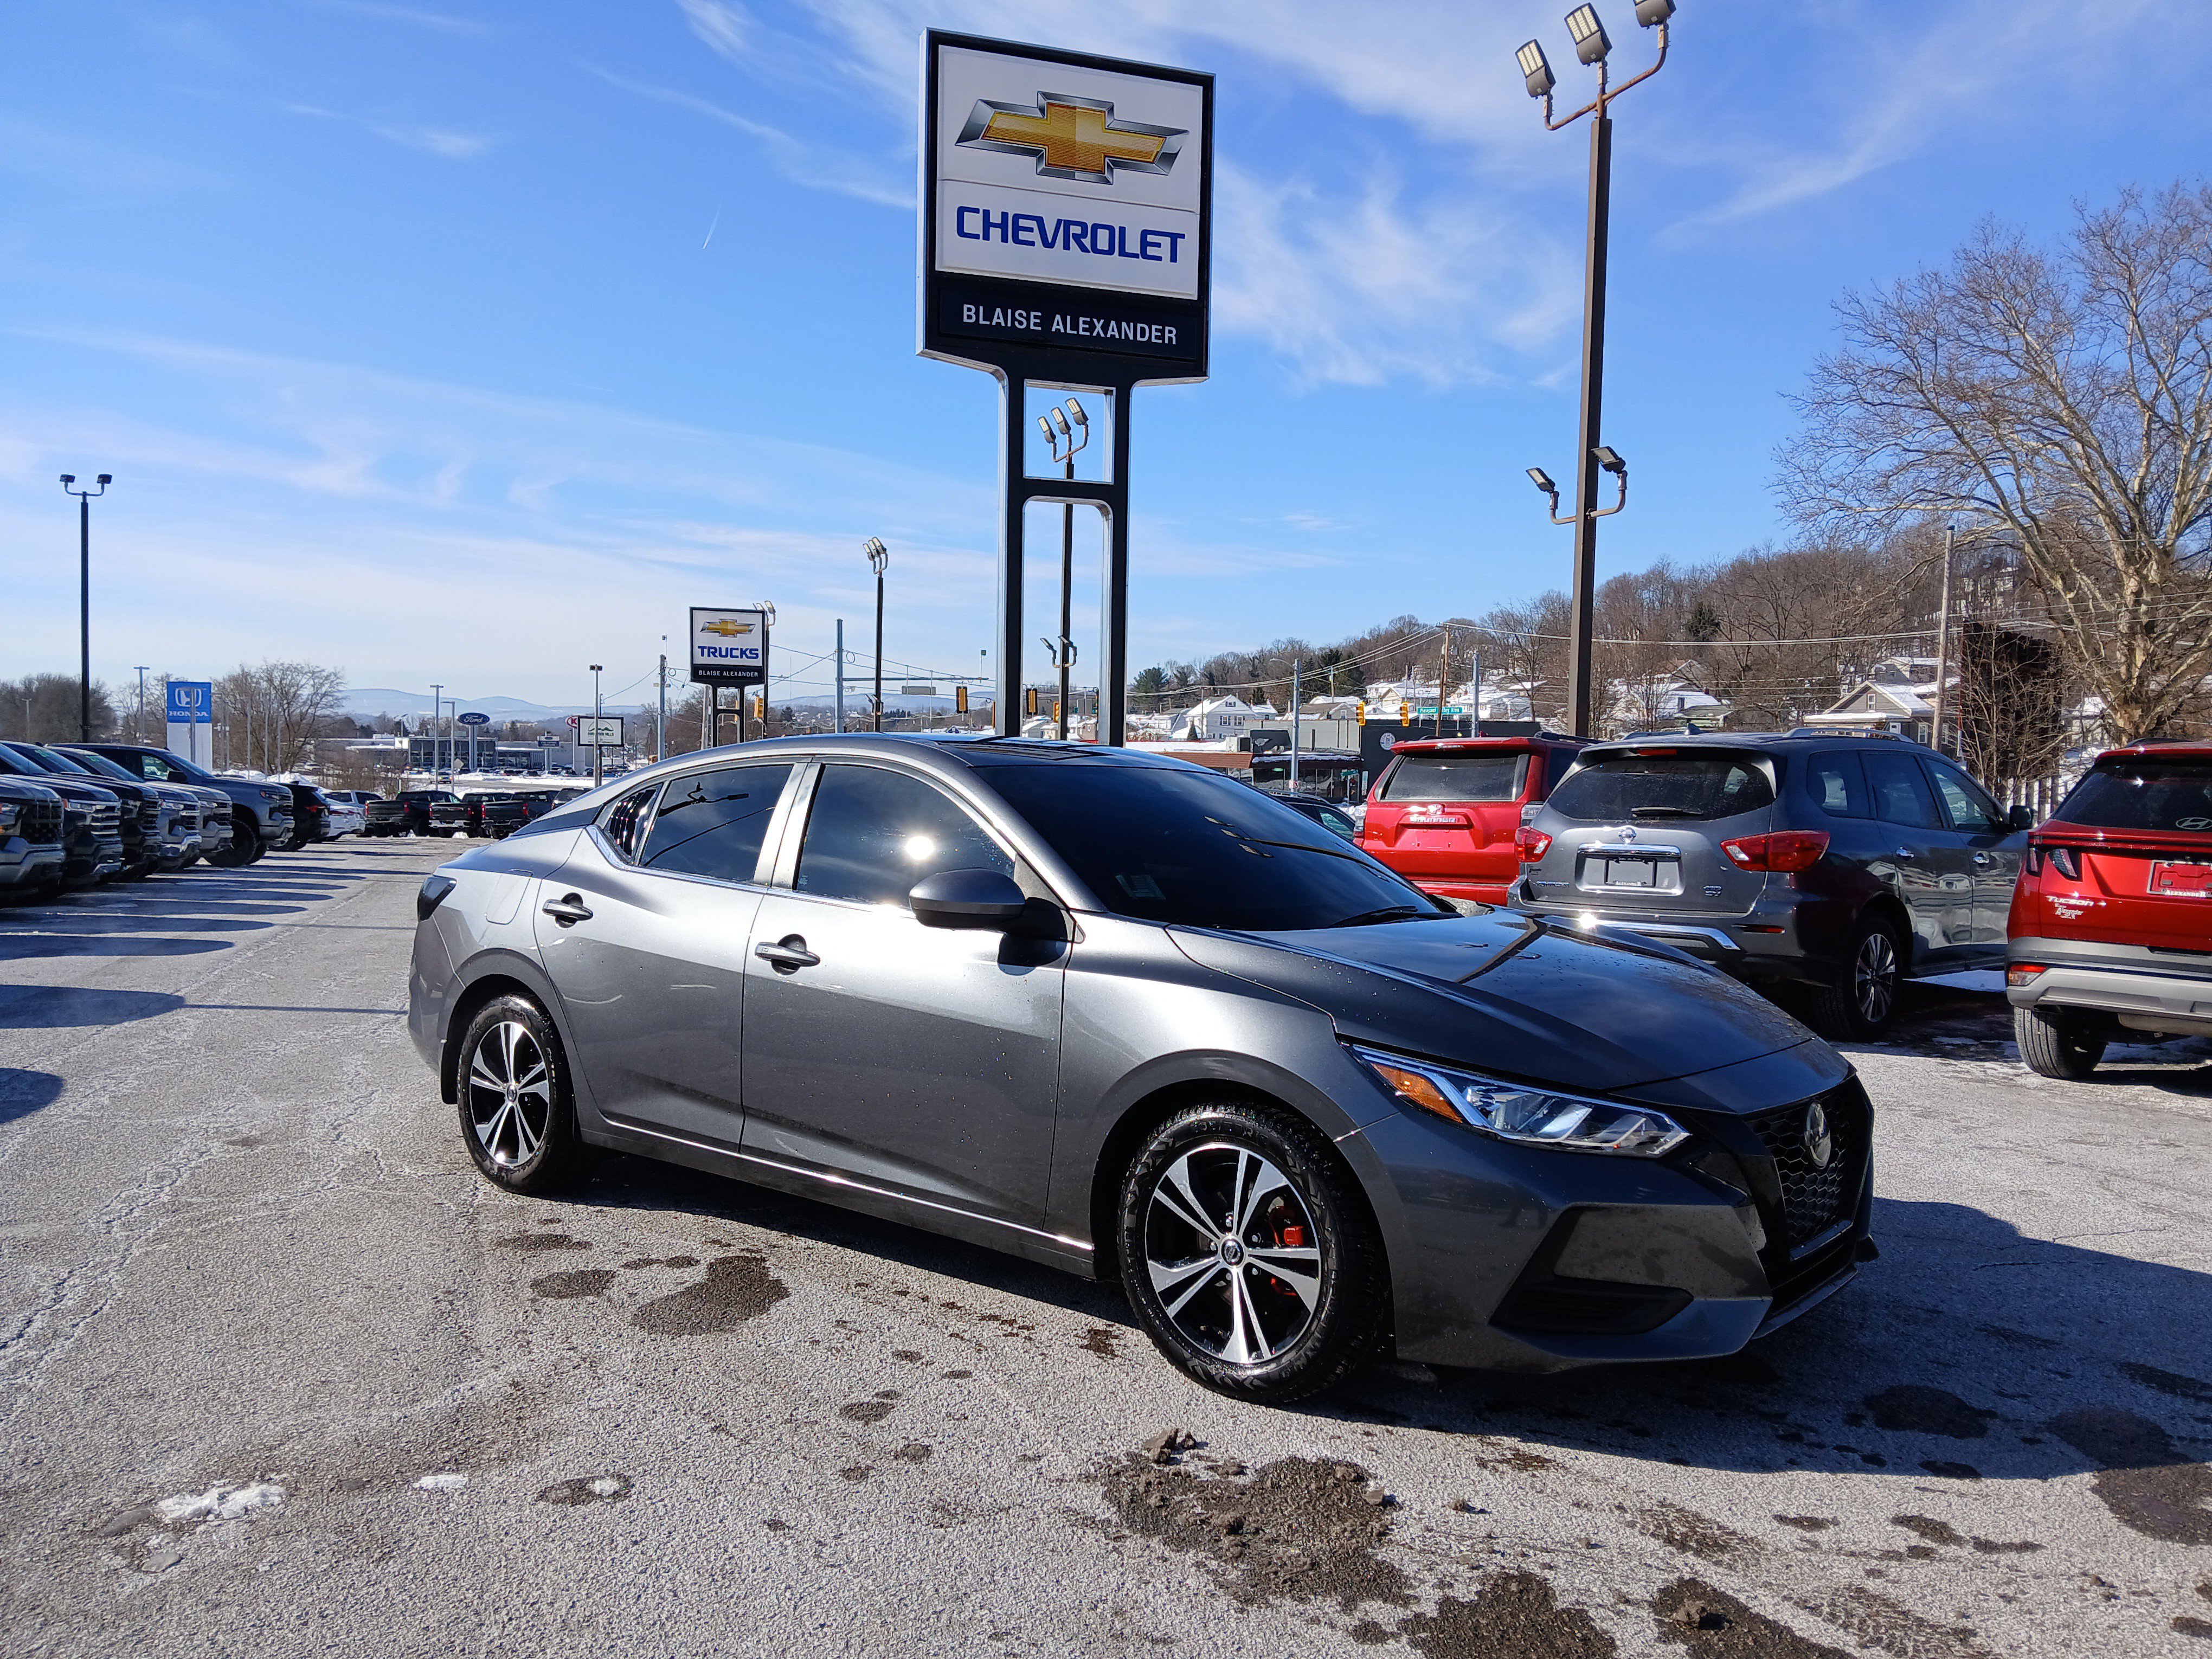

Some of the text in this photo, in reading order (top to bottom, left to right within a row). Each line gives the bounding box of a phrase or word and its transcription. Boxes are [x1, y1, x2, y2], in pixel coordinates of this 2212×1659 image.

[957, 205, 1186, 263] CHEVROLET
[963, 304, 1177, 345] BLAISE ALEXANDER
[697, 646, 759, 659] TRUCKS
